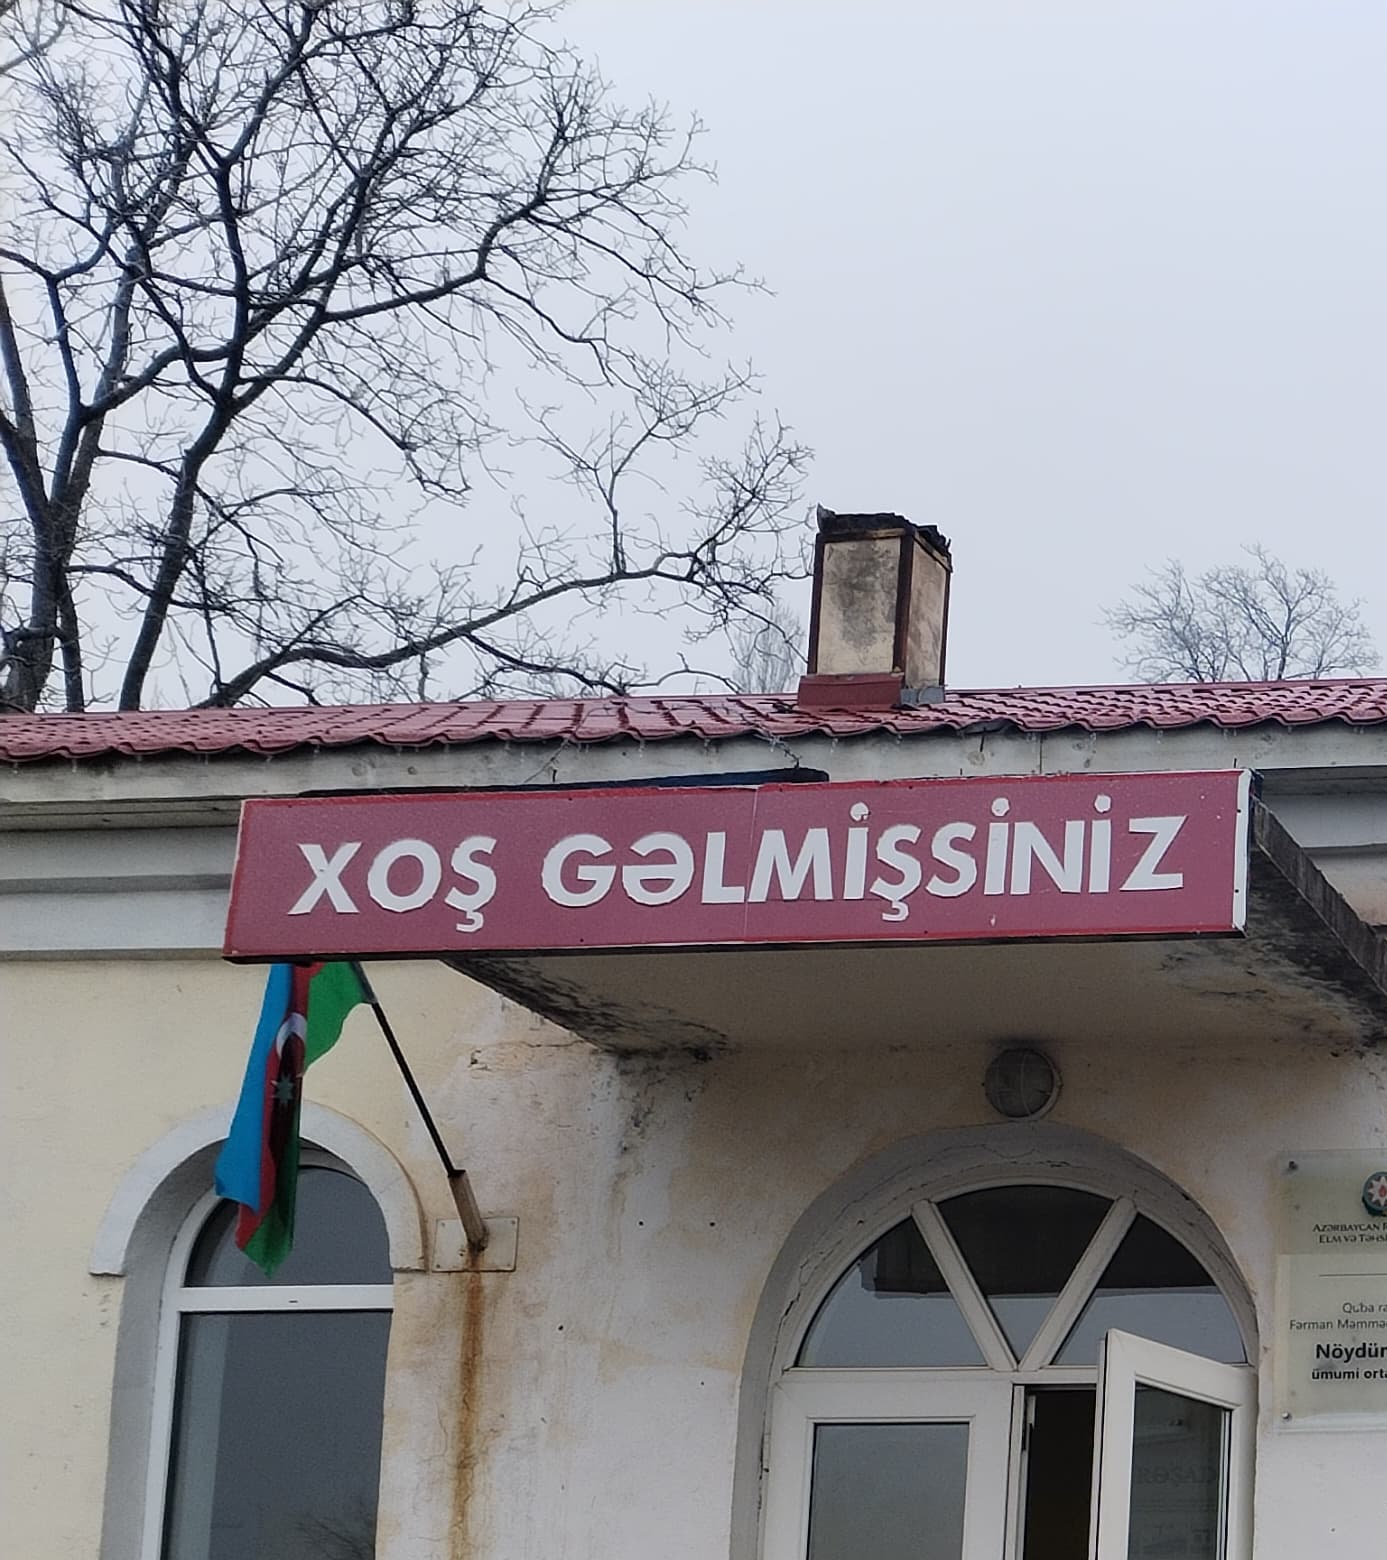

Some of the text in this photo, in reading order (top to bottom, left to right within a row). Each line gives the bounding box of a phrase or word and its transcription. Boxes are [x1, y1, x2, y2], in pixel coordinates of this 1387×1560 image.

[288, 794, 1187, 933] XOŞ GƏLMİŞSİNİZ
[1312, 1223, 1380, 1233] AZƏRBAYCAN
[1342, 1302, 1375, 1314] Quba
[1289, 1319, 1333, 1330] Fərman
[1311, 1367, 1359, 1380] ümumi
